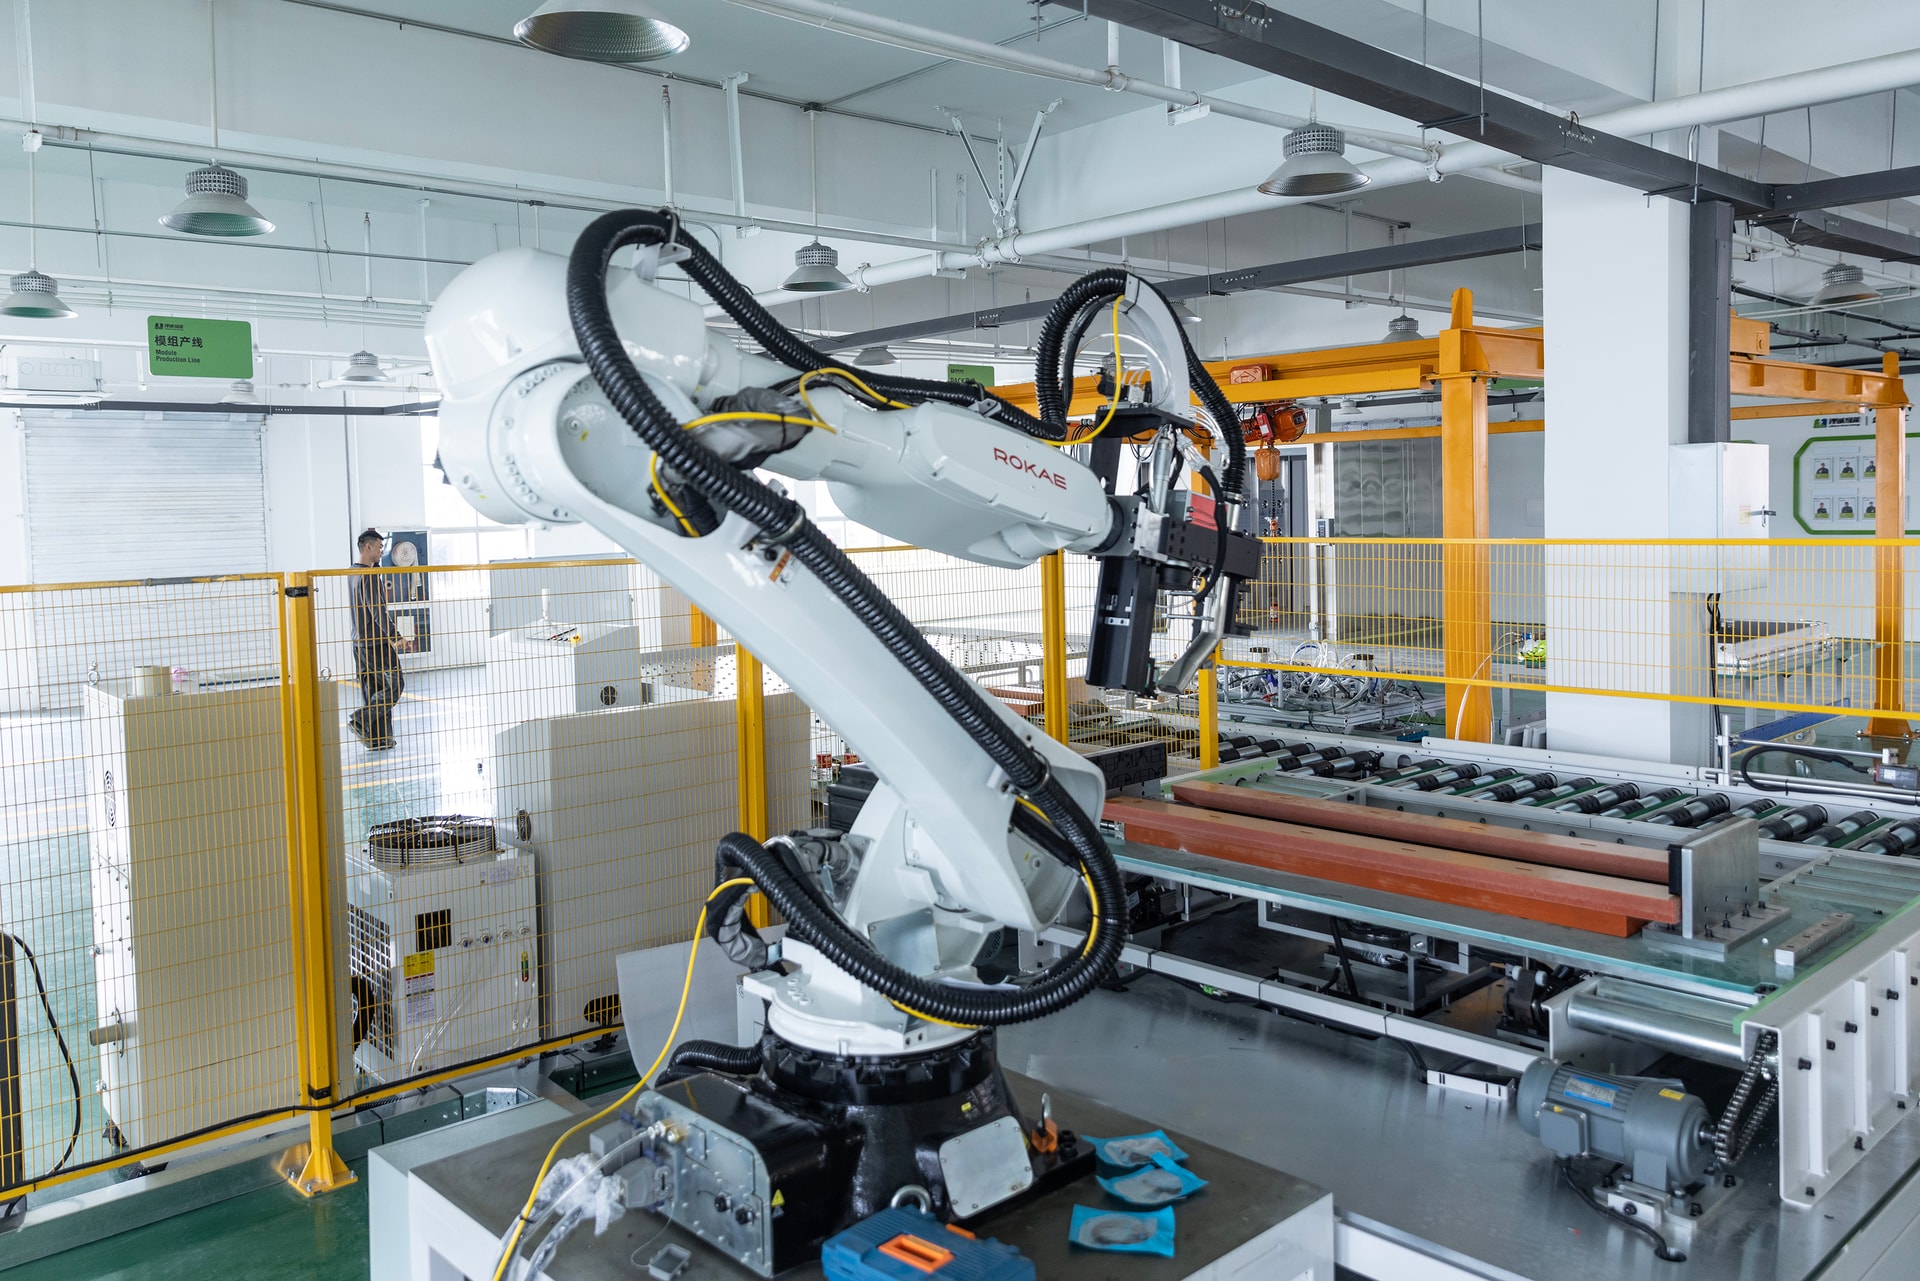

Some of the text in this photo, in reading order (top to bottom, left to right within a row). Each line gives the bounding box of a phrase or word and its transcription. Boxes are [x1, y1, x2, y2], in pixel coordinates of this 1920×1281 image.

[155, 335, 203, 348] 模组产线
[993, 447, 1067, 490] ROKAE
